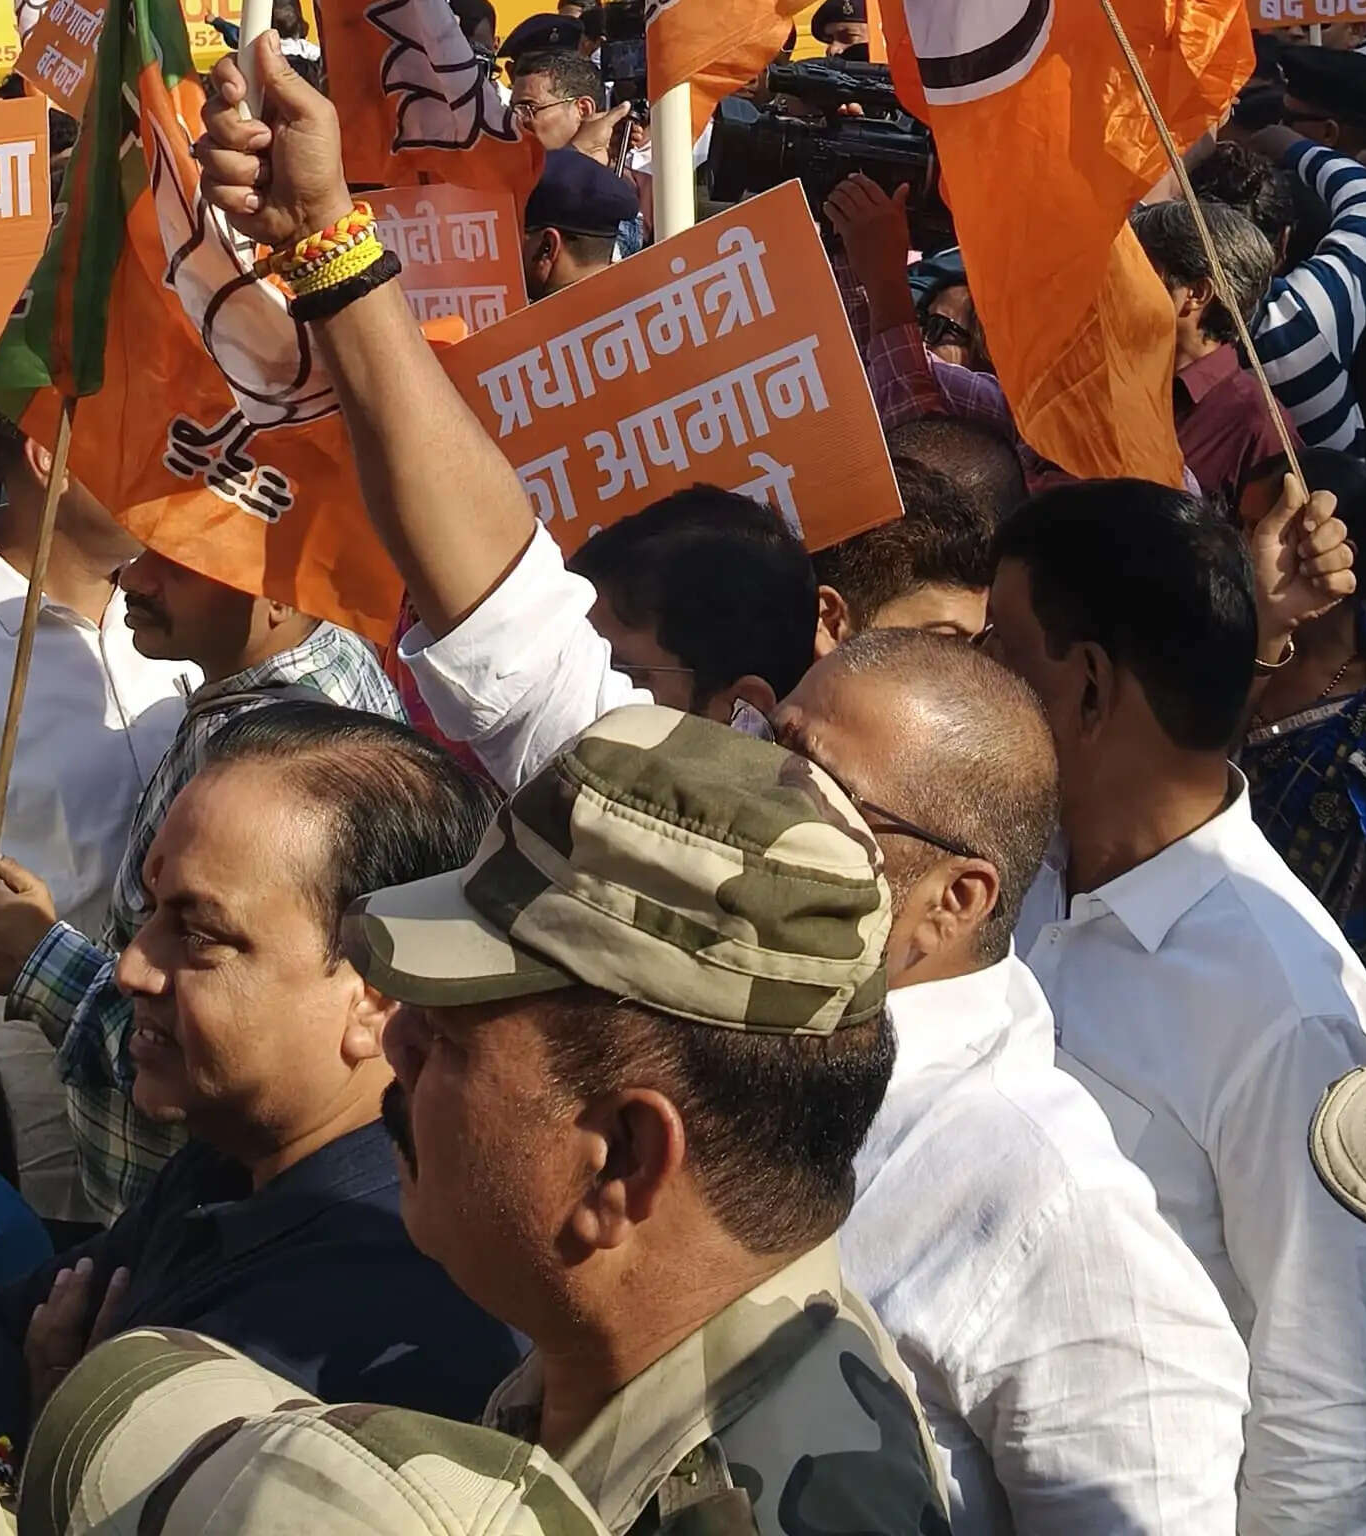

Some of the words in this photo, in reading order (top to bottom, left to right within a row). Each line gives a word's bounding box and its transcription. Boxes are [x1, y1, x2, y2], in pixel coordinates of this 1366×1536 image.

[446, 210, 500, 263] का
[477, 226, 777, 439] प्रधानमंत्री
[584, 333, 831, 501] अपमान
